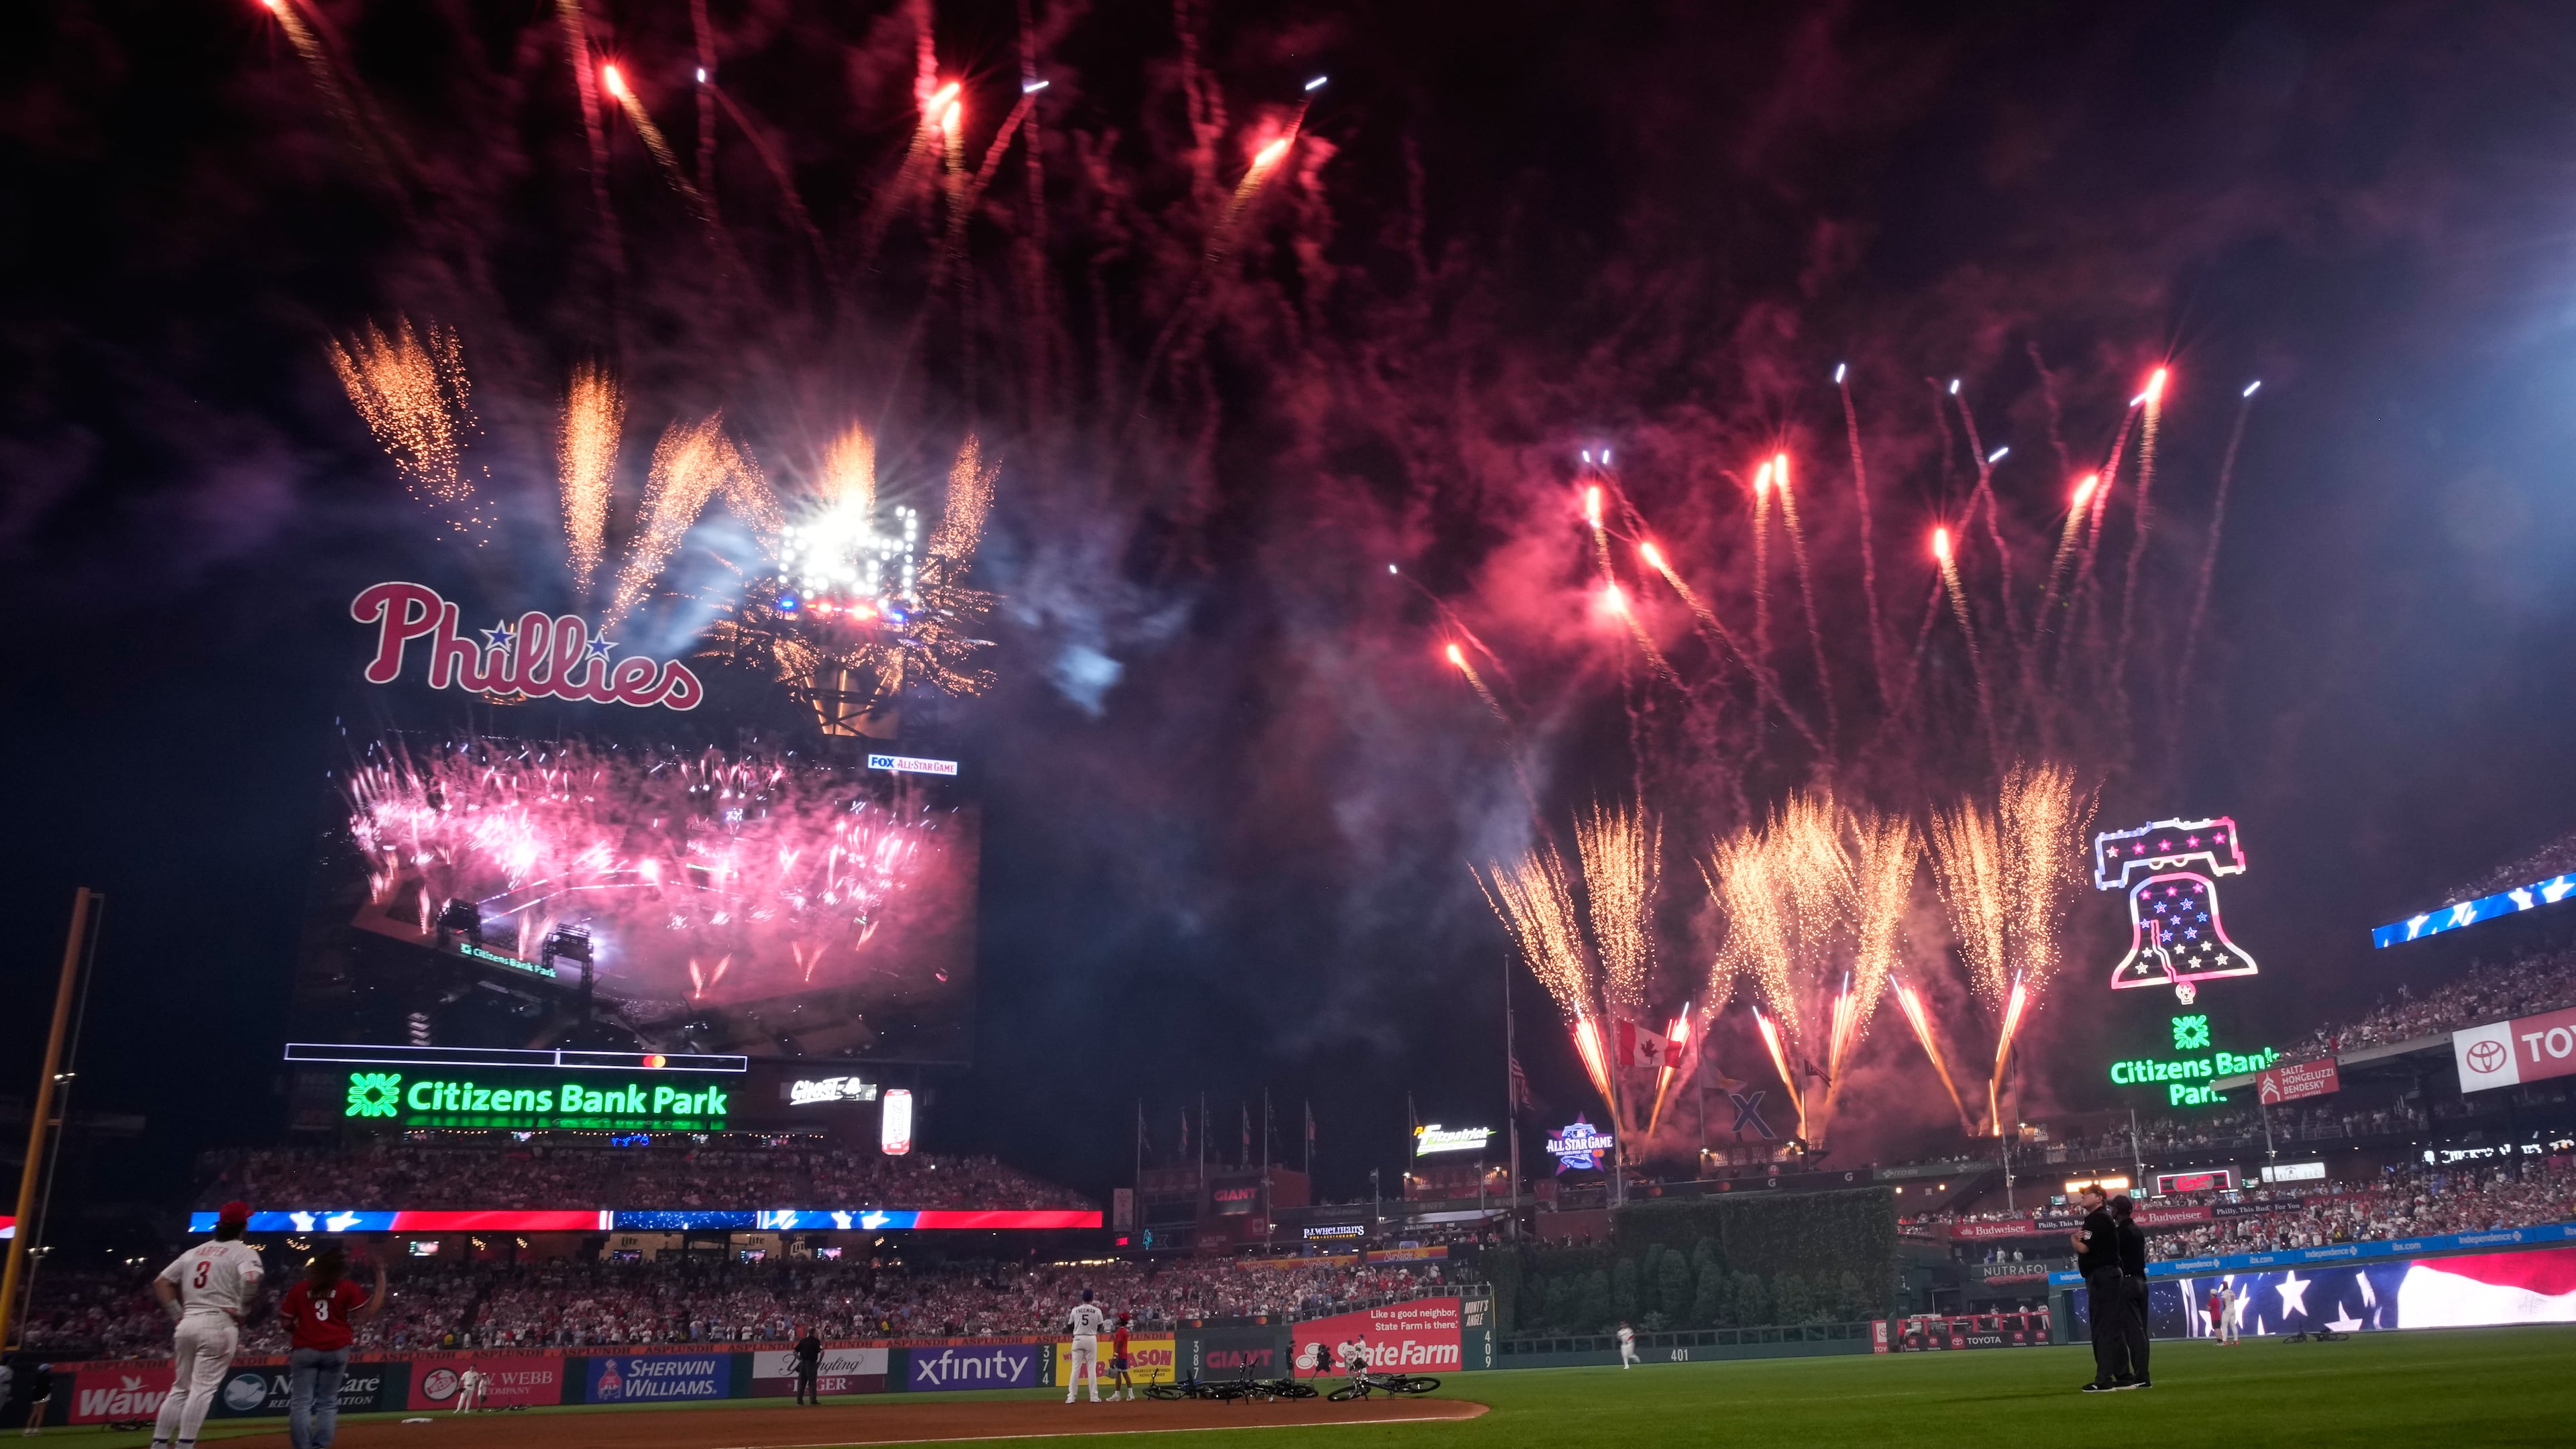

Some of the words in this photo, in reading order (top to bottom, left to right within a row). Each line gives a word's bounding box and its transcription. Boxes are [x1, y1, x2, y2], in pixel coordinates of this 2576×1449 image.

[350, 581, 703, 711] Phillies
[871, 757, 894, 768] FOX
[934, 762, 955, 773] GAME
[473, 948, 509, 965] Citizens
[509, 958, 534, 972] Bank
[534, 965, 556, 978] Park
[2110, 1058, 2212, 1084] Citizens
[2281, 1064, 2304, 1076] SALTZ
[2282, 1067, 2334, 1085] MONGELUZZI
[790, 1077, 849, 1105] GHOST
[2284, 1079, 2324, 1095] BENDESKY
[407, 1081, 552, 1112] Citizens
[559, 1083, 647, 1114] Bank
[653, 1085, 727, 1116] Park
[1417, 1124, 1489, 1145] Fitzpatrick
[2035, 1124, 2048, 1136] 42
[1546, 1139, 1564, 1152] ALL
[1565, 1138, 1587, 1150] STAR
[1588, 1136, 1613, 1148] GAME
[2304, 1170, 2318, 1178] BAR
[1214, 1187, 1257, 1201] GIANT
[2216, 1207, 2238, 1216] Philly.
[2038, 1221, 2058, 1229] Philly.
[621, 1236, 638, 1246] Lite
[749, 1236, 764, 1246] Lite
[2459, 1233, 2512, 1244] Independence
[2392, 1241, 2421, 1251] ibx.com
[1383, 1250, 1413, 1261] Surfside
[2305, 1248, 2349, 1259] Independence
[2176, 1260, 2212, 1270] Independence
[2249, 1256, 2273, 1265] ibx.com
[193, 1260, 212, 1289] 3
[1984, 1264, 2050, 1276] NUTRAFOL
[315, 1299, 329, 1321] 3
[1464, 1299, 1489, 1315] MONTY'S
[1081, 1314, 1089, 1326] 5
[1371, 1310, 1388, 1319] Like
[1397, 1309, 1417, 1320] good
[1419, 1308, 1457, 1319] neighbor,
[1466, 1313, 1485, 1327] ANGLE
[1375, 1322, 1397, 1331] State
[1401, 1321, 1423, 1330] Farm
[1424, 1321, 1431, 1329] is
[962, 1336, 1023, 1345] ASPLUNDH
[1966, 1336, 2001, 1345] TOYOTA
[560, 1346, 631, 1356] ASPLUNDH
[645, 1345, 714, 1354] ASPLUNDH
[728, 1342, 795, 1352] ASPLUNDH
[1400, 1340, 1459, 1366] Farm
[381, 1351, 455, 1362] ASPLUNDH
[472, 1349, 545, 1358] ASPLUNDH
[1206, 1349, 1273, 1368] GIANT
[1671, 1348, 1688, 1361] 401
[82, 1358, 168, 1371] ASPLUNDH
[628, 1359, 716, 1377] SHERWIN
[916, 1349, 1028, 1385] xfinity
[1042, 1345, 1050, 1385] 374
[501, 1371, 553, 1385] WEBB
[486, 1387, 531, 1395] COMPANY
[625, 1379, 714, 1397] WILLIAMS
[80, 1388, 168, 1417] Waw
